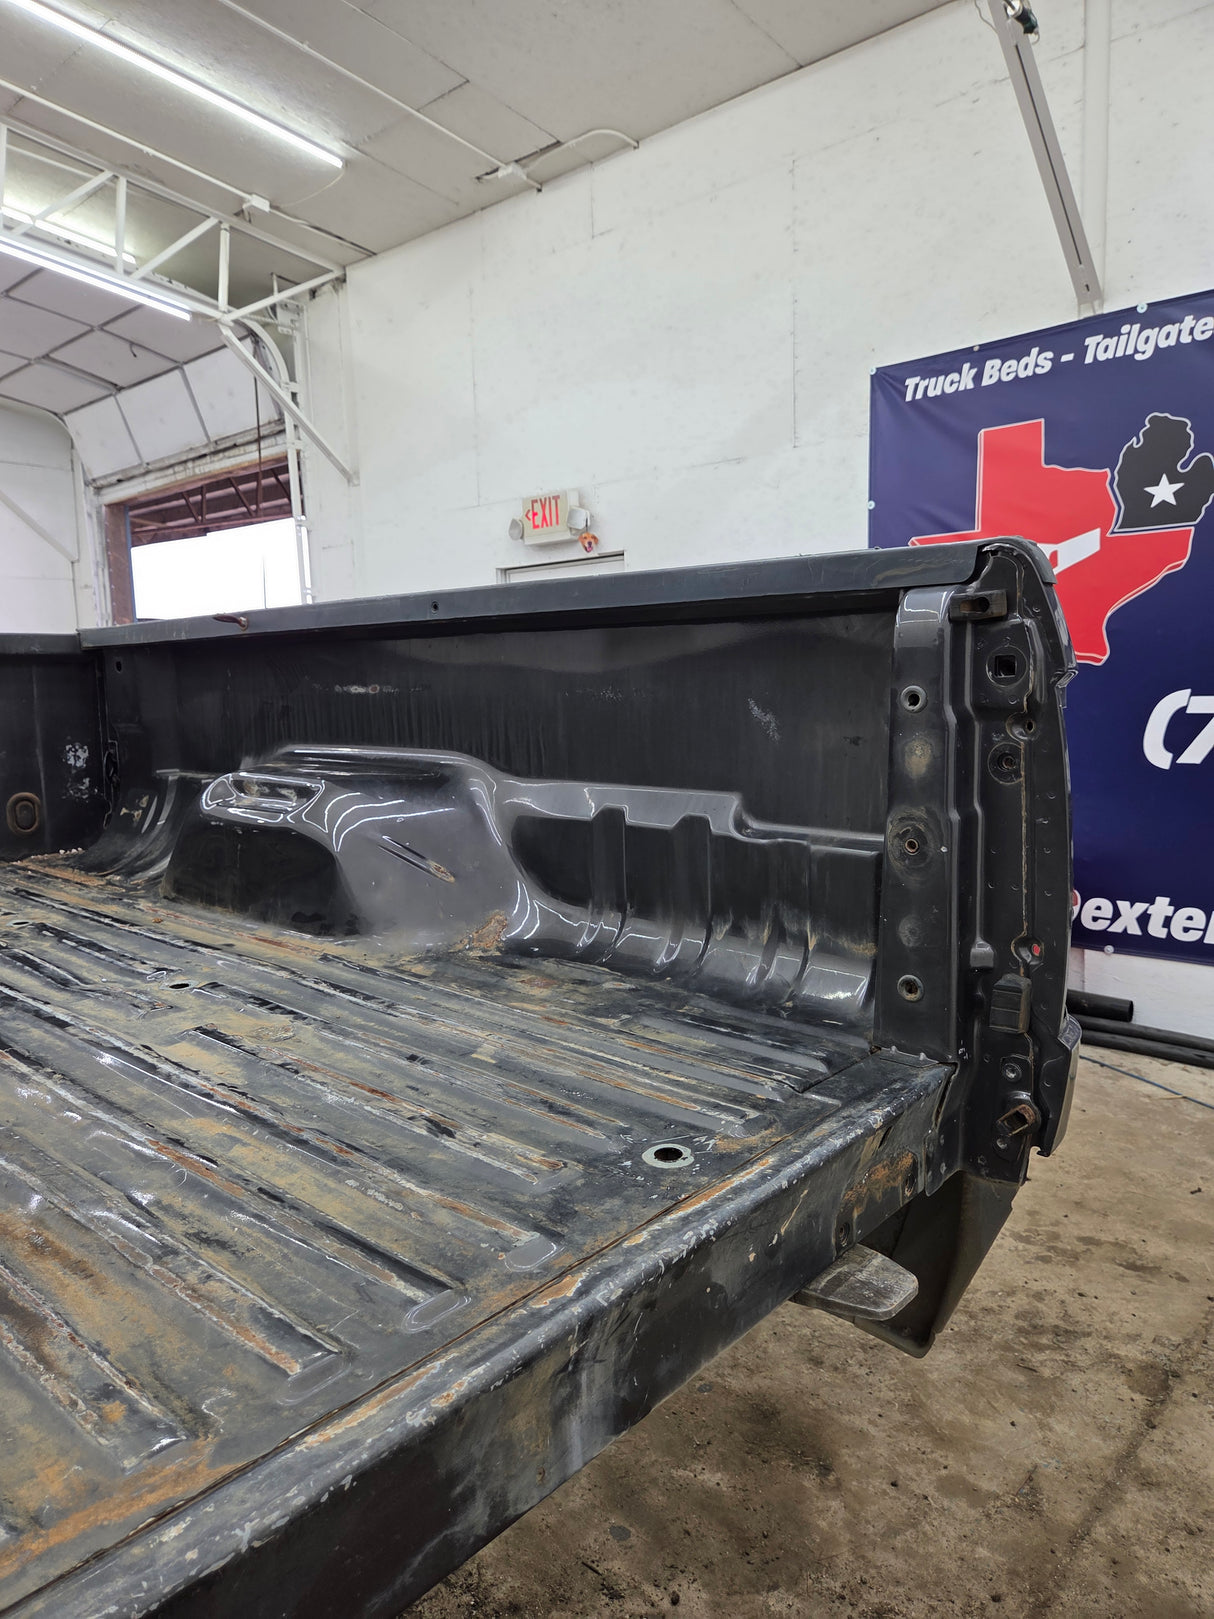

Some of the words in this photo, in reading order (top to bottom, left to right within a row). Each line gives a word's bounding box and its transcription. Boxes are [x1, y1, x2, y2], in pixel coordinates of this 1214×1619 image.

[905, 362, 976, 402] Truck
[981, 346, 1053, 387] Beds
[1060, 352, 1074, 363] -
[531, 495, 560, 529] EXIT
[1072, 889, 1214, 944] exte
